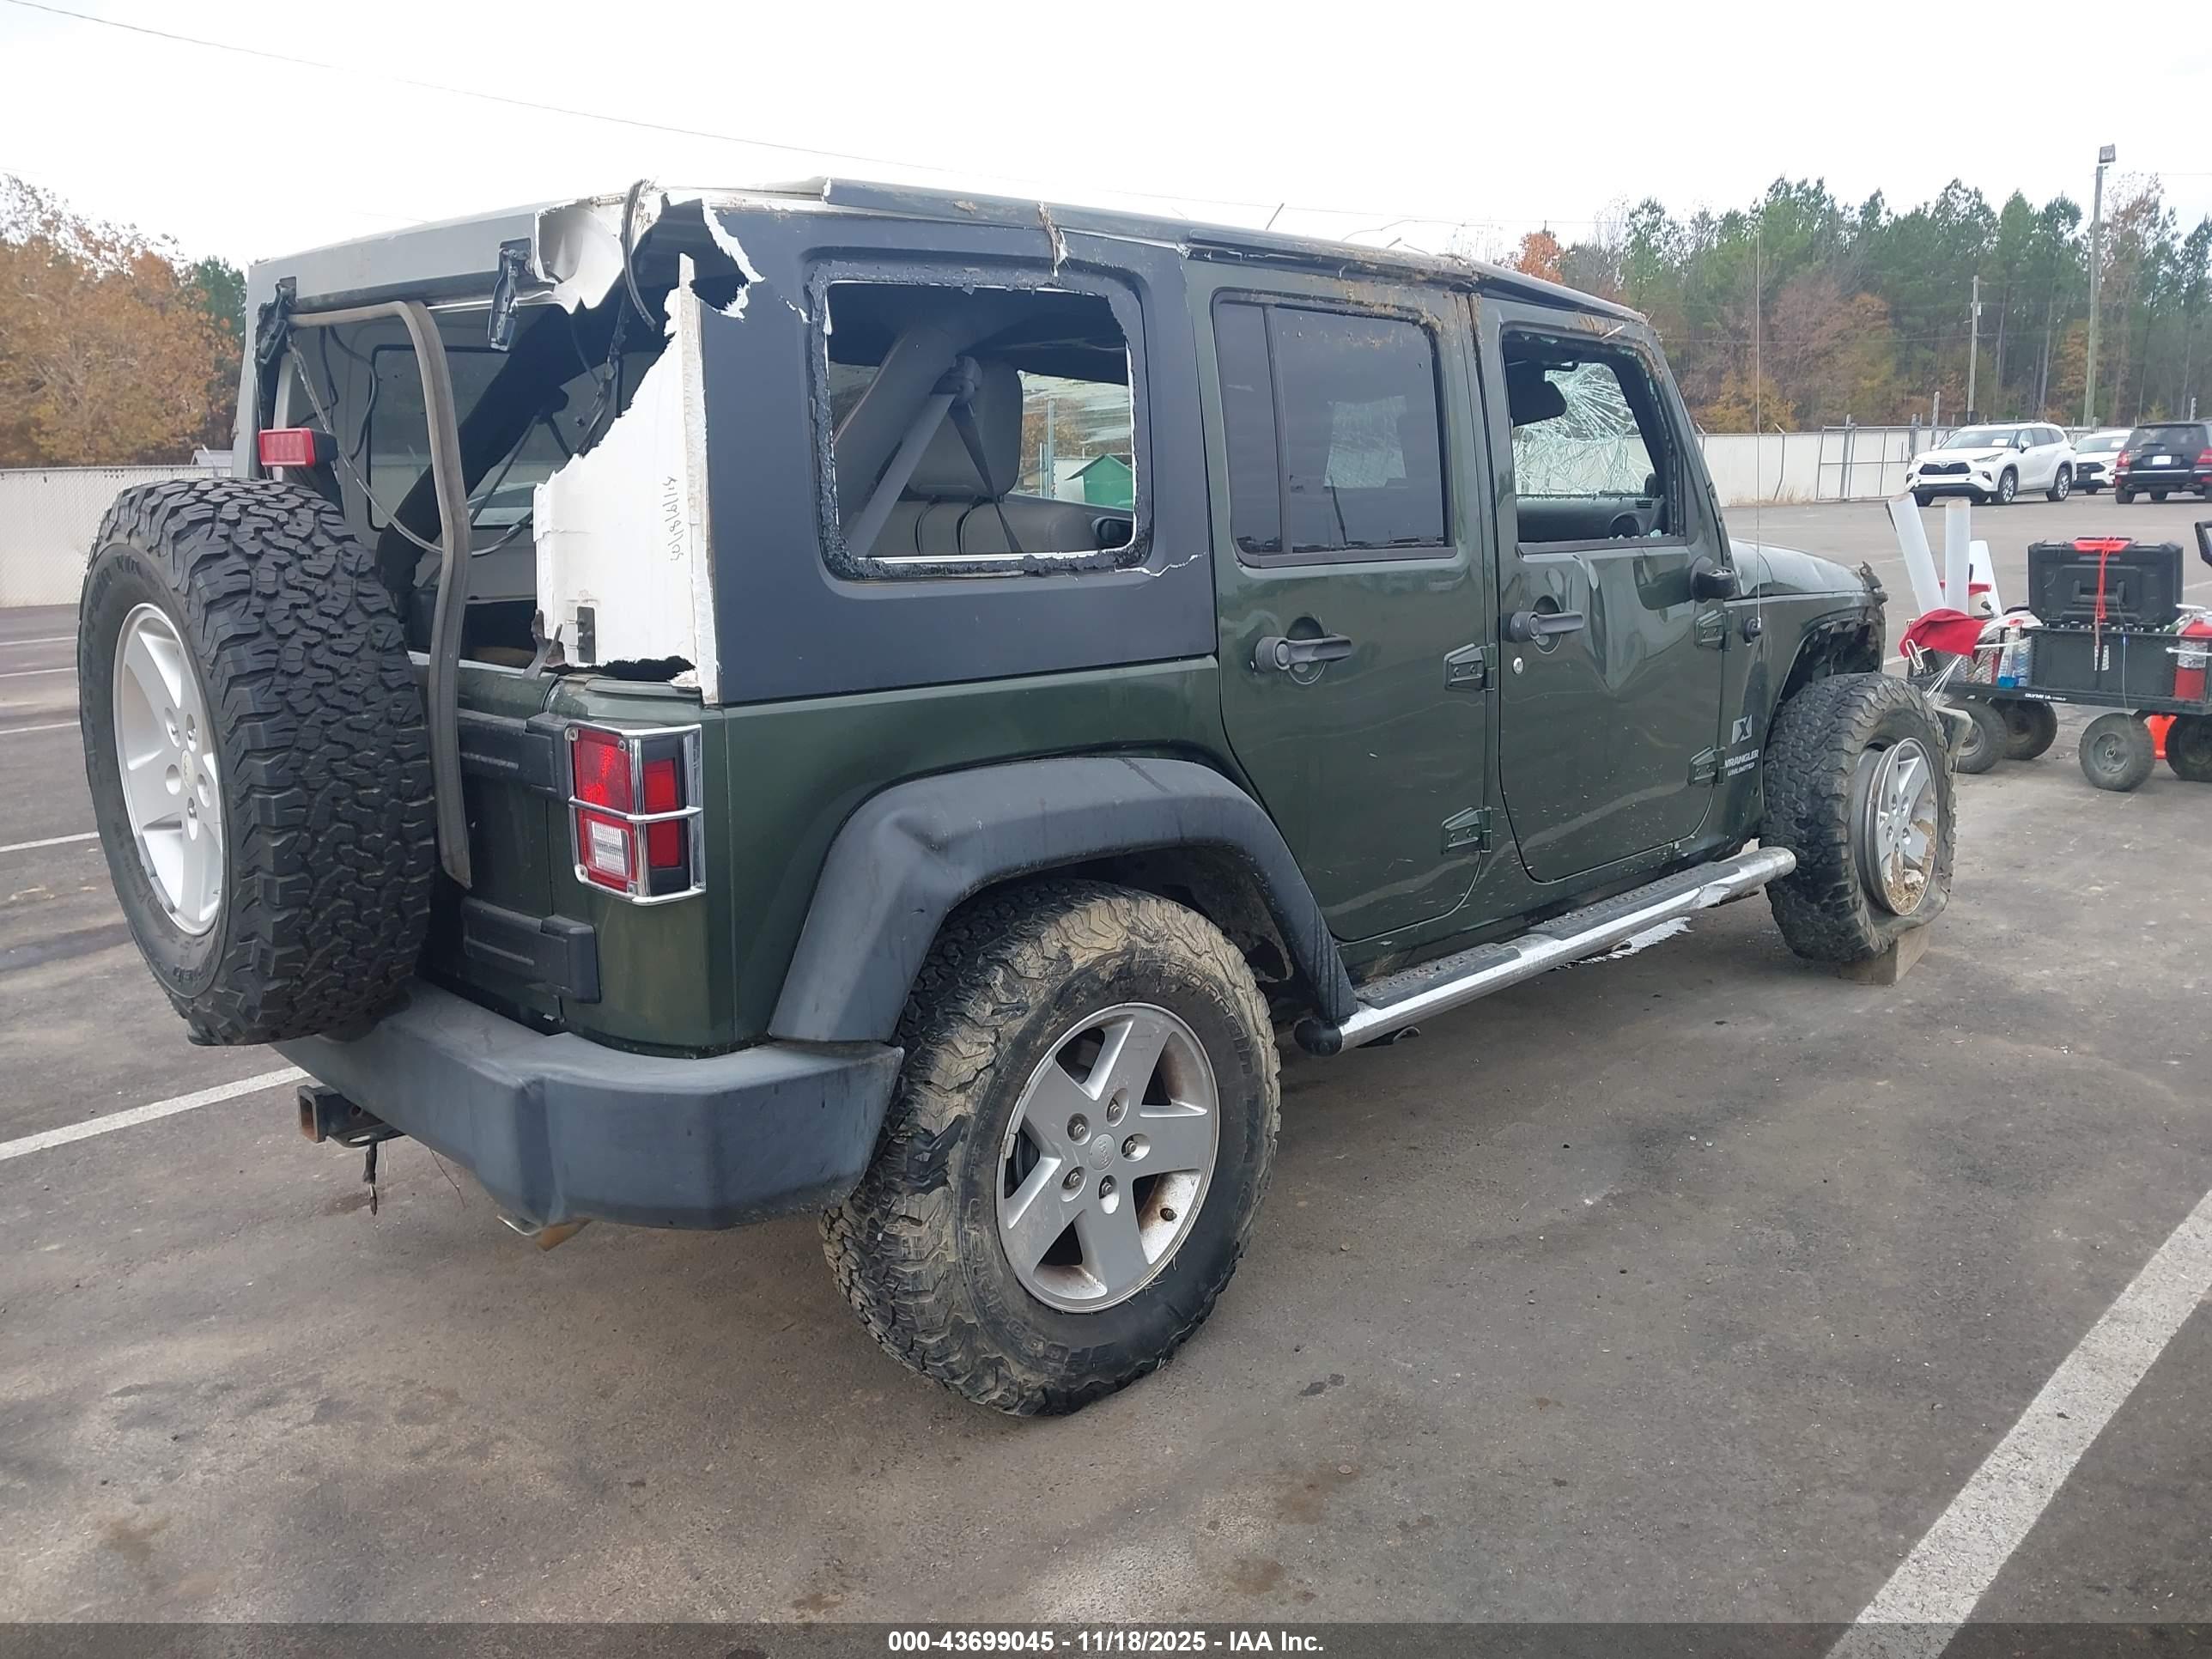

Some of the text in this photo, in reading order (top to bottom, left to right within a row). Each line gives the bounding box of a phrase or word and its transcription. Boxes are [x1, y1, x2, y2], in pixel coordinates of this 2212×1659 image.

[1732, 714, 1752, 744] X
[1724, 749, 1759, 768] WRANGLER
[1727, 762, 1754, 776] UNLIMITED
